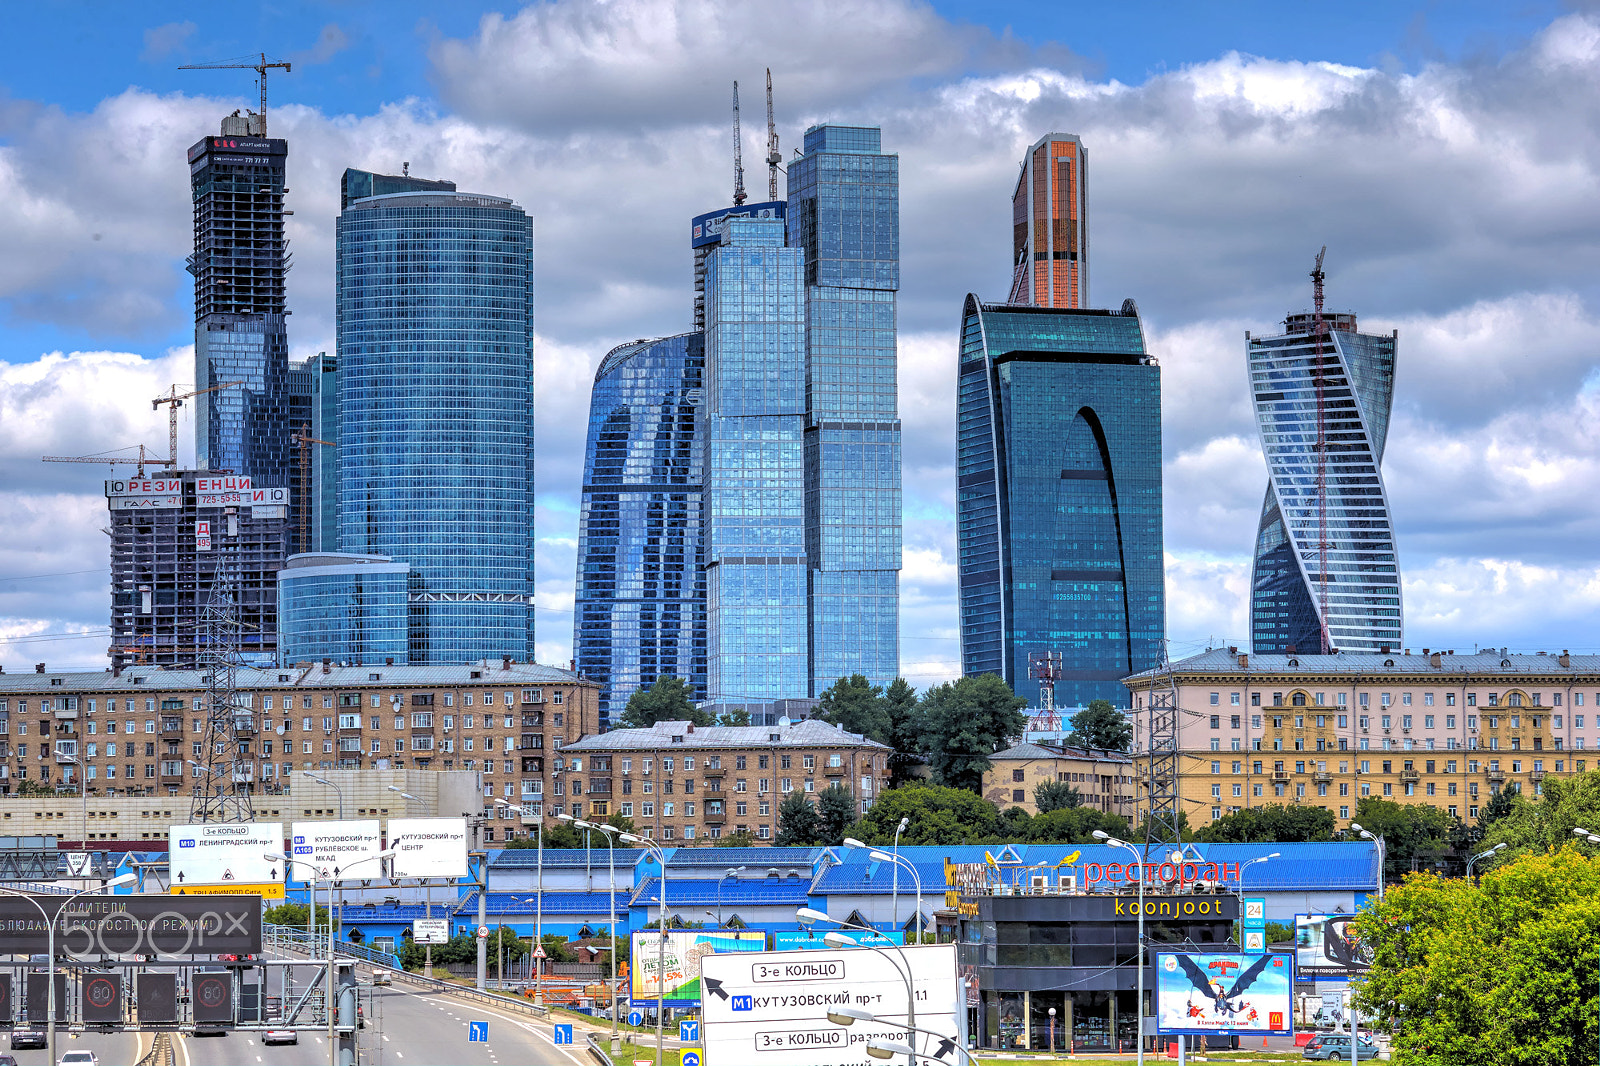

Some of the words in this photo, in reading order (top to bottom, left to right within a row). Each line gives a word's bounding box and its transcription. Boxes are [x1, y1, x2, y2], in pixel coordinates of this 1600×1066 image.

[129, 480, 180, 492] РЕЗИ
[197, 522, 210, 536] Д
[197, 539, 211, 547] 495
[181, 840, 195, 848] М10
[199, 838, 258, 847] ЛЕНИНГРАДСКИЙ
[315, 835, 363, 843] КУТУЗОВСКИЙ
[402, 833, 449, 841] КУТУЗОВСКИЙ
[1084, 862, 1240, 890] ресторан
[60, 903, 126, 913] ВОДИТЕЛИ
[1115, 898, 1222, 918] koonjoot
[1248, 905, 1261, 915] 24
[760, 965, 780, 977] 3-е
[785, 964, 837, 977] КОЛЬЦО
[93, 987, 110, 999] 80
[204, 987, 221, 999] 80
[733, 996, 751, 1010] М1
[753, 991, 850, 1008] КУТУЗОВСКИЙ
[856, 994, 882, 1006] пр-т
[915, 991, 928, 1001] 1.1
[763, 1036, 783, 1046] 3-е
[788, 1033, 840, 1046] КОЛЬЦО
